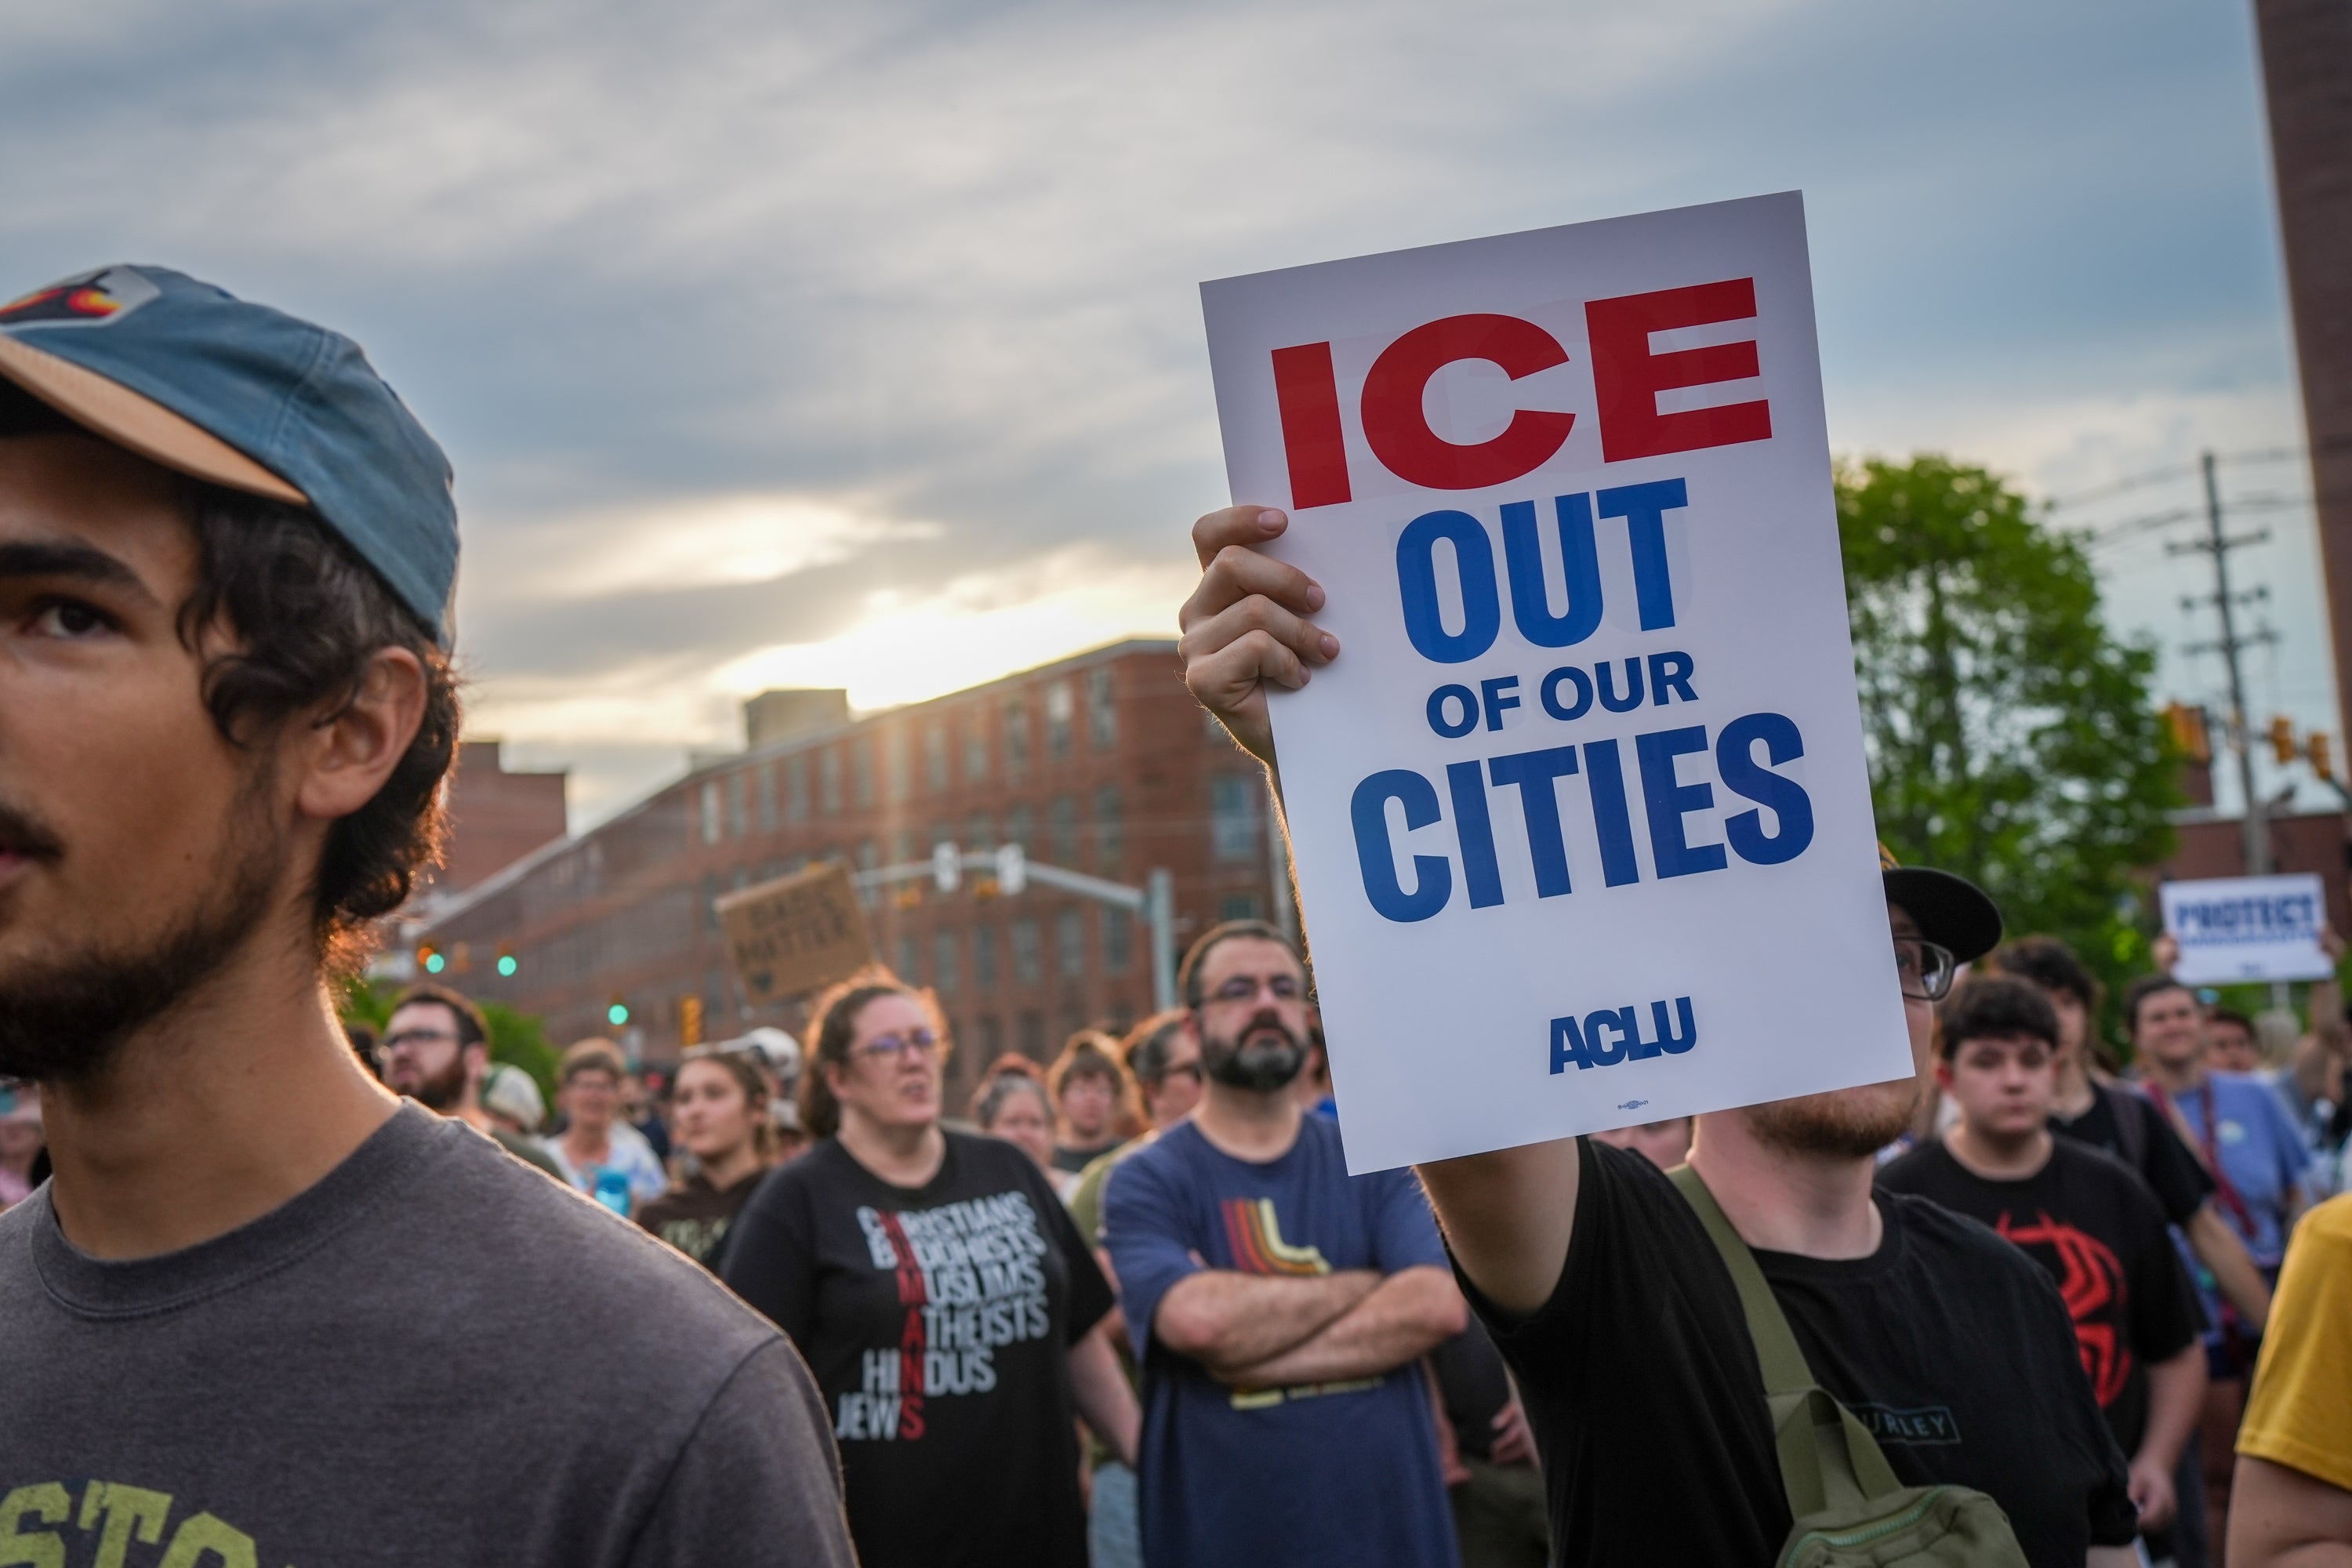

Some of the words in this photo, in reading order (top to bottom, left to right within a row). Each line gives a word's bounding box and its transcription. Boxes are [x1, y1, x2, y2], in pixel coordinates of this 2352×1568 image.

[1271, 277, 1772, 510] ICE
[1396, 477, 1688, 663] OUT
[1426, 675, 1520, 738] OF
[1540, 651, 1698, 720] OUR
[1351, 713, 1813, 922] CITIES
[2176, 894, 2314, 928] PROTECT
[1550, 996, 1697, 1075] ACLU
[857, 1191, 1036, 1240] CHRISTIANS
[867, 1225, 1047, 1269] BUDDHISTS
[896, 1255, 1045, 1308] MUSLIMS
[903, 1292, 1049, 1348] ATHEISTS
[863, 1347, 997, 1396] HINDUS
[837, 1392, 925, 1441] JEWS
[1861, 1413, 1944, 1436] URLEY
